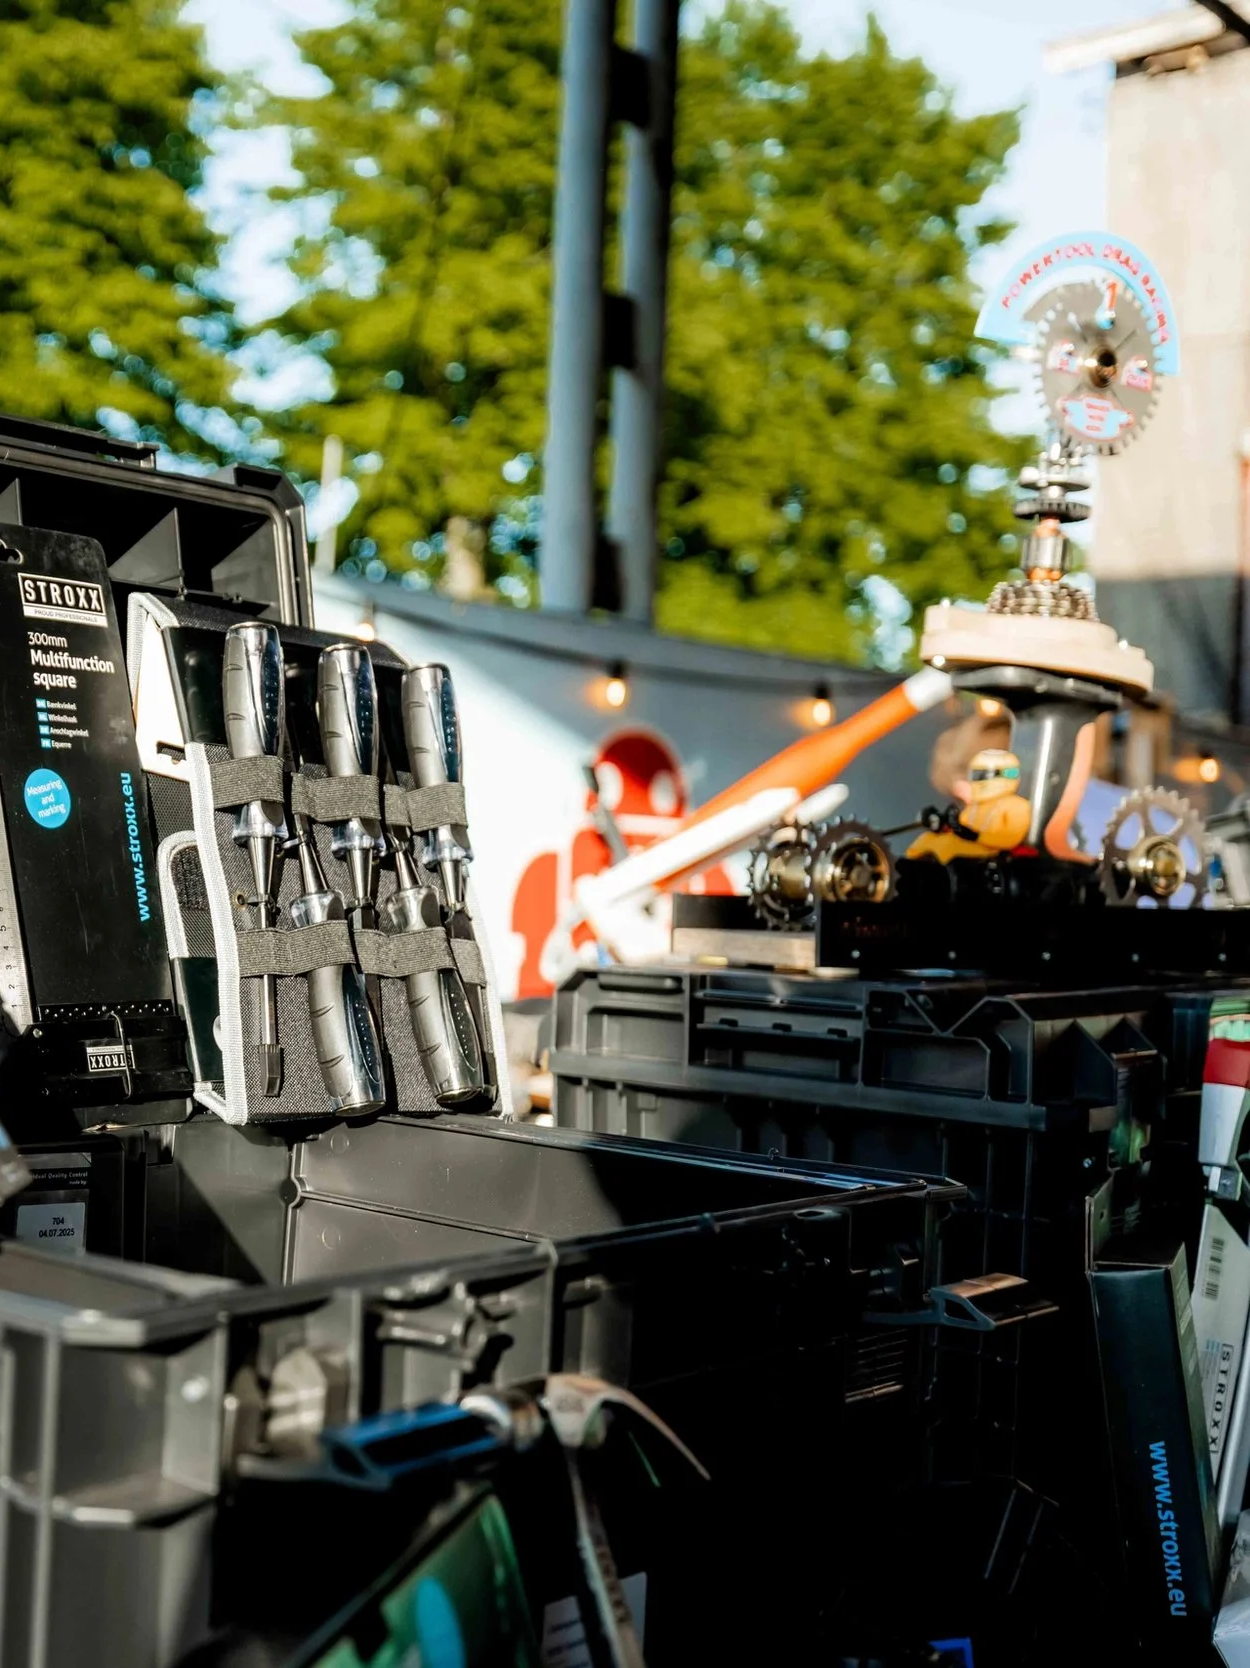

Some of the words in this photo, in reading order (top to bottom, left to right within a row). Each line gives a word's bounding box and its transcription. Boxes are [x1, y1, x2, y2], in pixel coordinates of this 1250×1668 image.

[24, 579, 101, 611] STROXX
[34, 609, 54, 617] PROUD
[55, 611, 98, 623] PROFESSIONALS
[27, 631, 68, 647] 300mm
[30, 648, 115, 673] Multifunction
[33, 672, 77, 690] square
[27, 780, 63, 796] Measuring
[41, 792, 55, 805] and
[37, 803, 66, 818] marking
[120, 772, 150, 921] www.stroxx.eu
[52, 1217, 64, 1225] 704
[1209, 1349, 1230, 1446] STROXX
[1149, 1441, 1187, 1616] www.stroxx.eu
